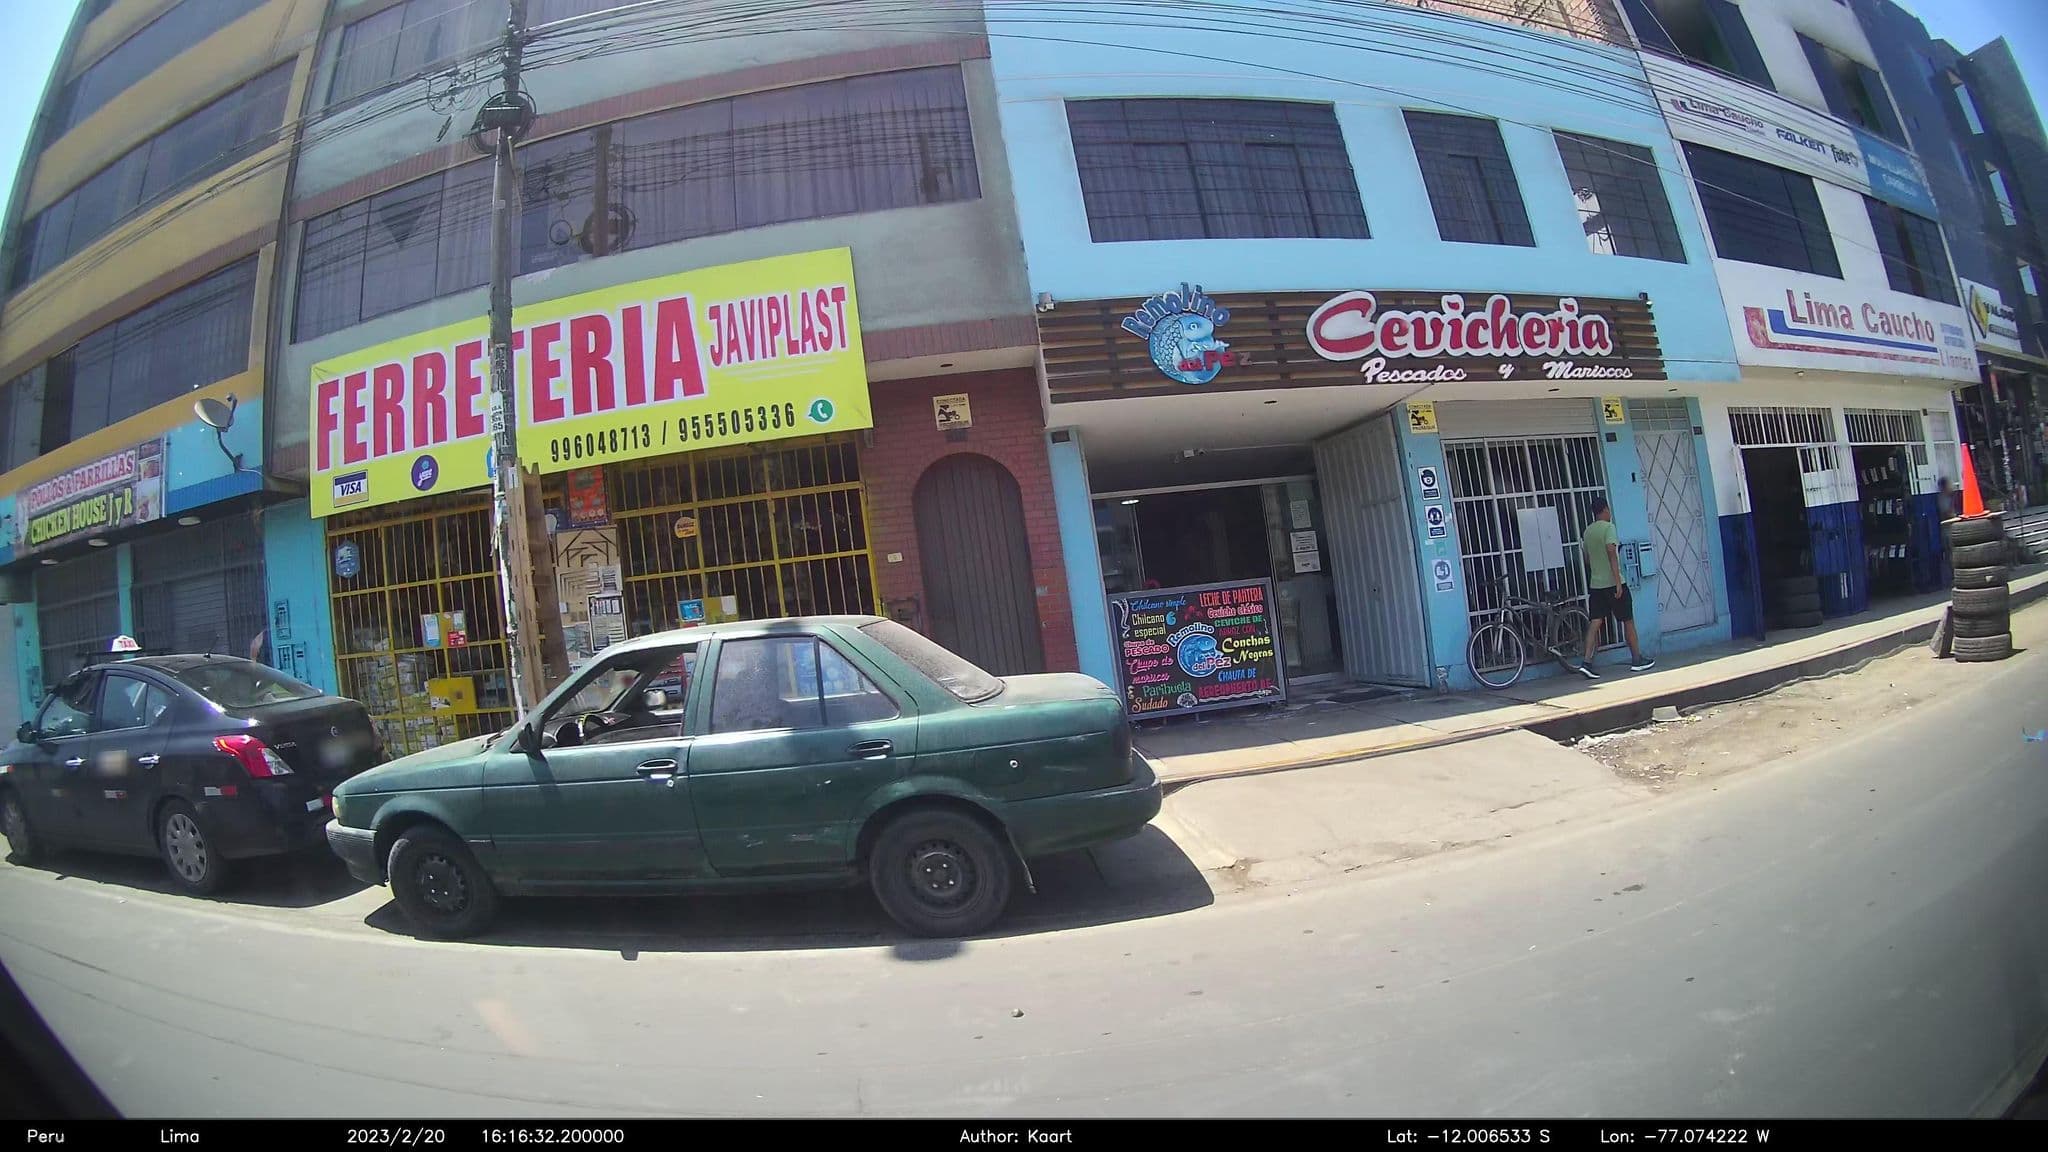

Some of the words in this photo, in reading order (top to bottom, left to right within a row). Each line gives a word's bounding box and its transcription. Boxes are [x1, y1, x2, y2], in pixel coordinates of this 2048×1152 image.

[1776, 128, 1826, 154] FALKEN
[1121, 282, 1231, 340] Remolino
[1786, 288, 1854, 331] Lima
[1861, 302, 1935, 343] Caucho
[709, 286, 847, 367] JAVIPLAST
[1308, 292, 1612, 359] Cevicheria
[1360, 357, 1467, 385] Pescados
[1498, 363, 1515, 380] y
[1543, 361, 1633, 380] Mariscos
[551, 423, 652, 463] 996048713
[679, 402, 795, 442] 955505336
[30, 479, 64, 513] POLLOS
[73, 451, 136, 491] PARRILLAS
[340, 481, 362, 497] VISA
[31, 507, 71, 545] CHICKEN
[72, 495, 107, 530] HOUSE
[124, 488, 133, 515] R
[1200, 591, 1222, 607] LECHE
[1222, 590, 1232, 604] DE
[1232, 587, 1264, 604] PANTERA
[1132, 613, 1165, 626] Chilcano
[1214, 616, 1251, 628] CEVICHE
[1252, 615, 1263, 623] DE
[1134, 623, 1167, 639] especial
[1167, 622, 1215, 647] Remolino
[1124, 644, 1170, 657] PESCADO
[1222, 635, 1271, 653] Conchas
[1205, 656, 1232, 669] Pez
[1233, 649, 1274, 664] Negras
[1247, 667, 1257, 678] DE
[1142, 681, 1192, 697] Parihuela
[1131, 696, 1169, 713] Sudado
